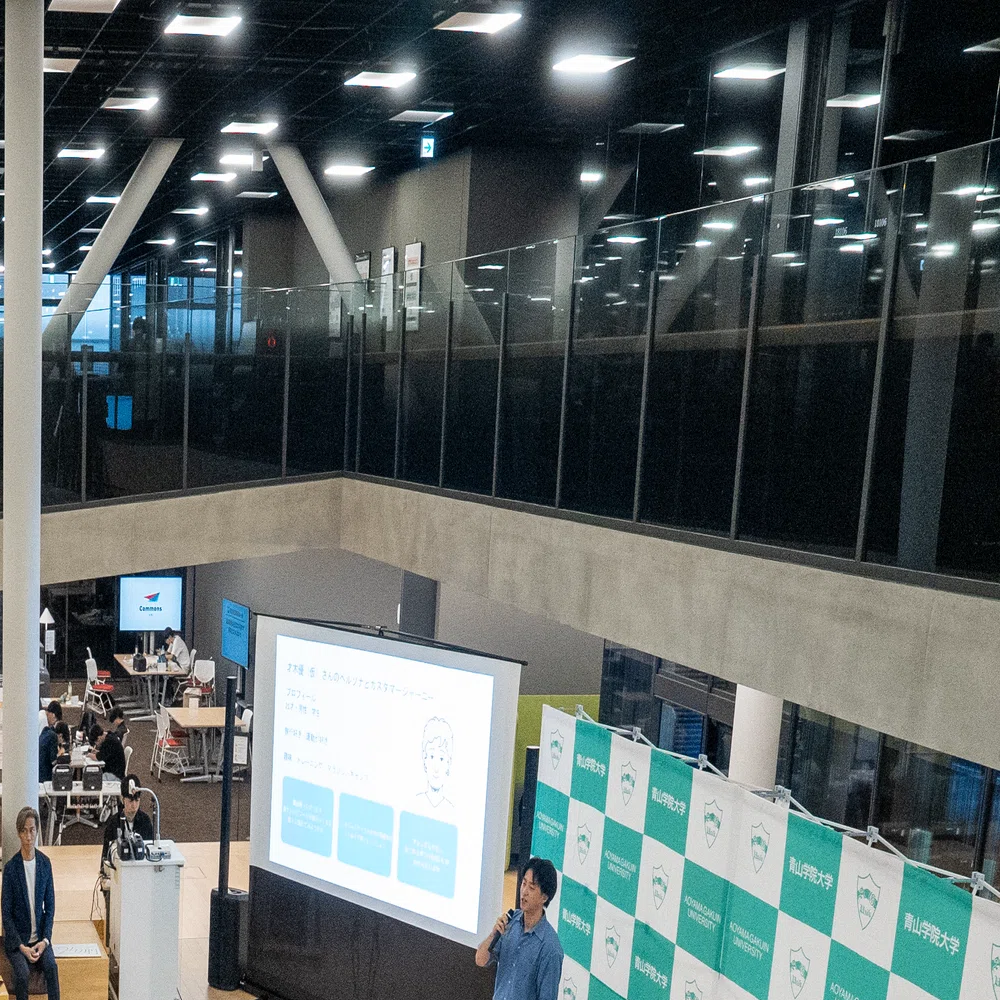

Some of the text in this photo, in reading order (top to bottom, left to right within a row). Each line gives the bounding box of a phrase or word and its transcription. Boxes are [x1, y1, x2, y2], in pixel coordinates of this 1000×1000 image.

[652, 787, 686, 816] 青山学院大学
[789, 856, 833, 890] 青山学院大学
[562, 908, 591, 936] 青山学院大学
[684, 896, 721, 923] AOYAMA GAKUIN
[688, 908, 716, 932] UNIVERSITY
[730, 921, 769, 953] AOYAMA GAKUIN
[733, 935, 763, 959] UNIVERSITY
[904, 912, 959, 956] 青山学院大学
[635, 955, 668, 989] 青山学院大学
